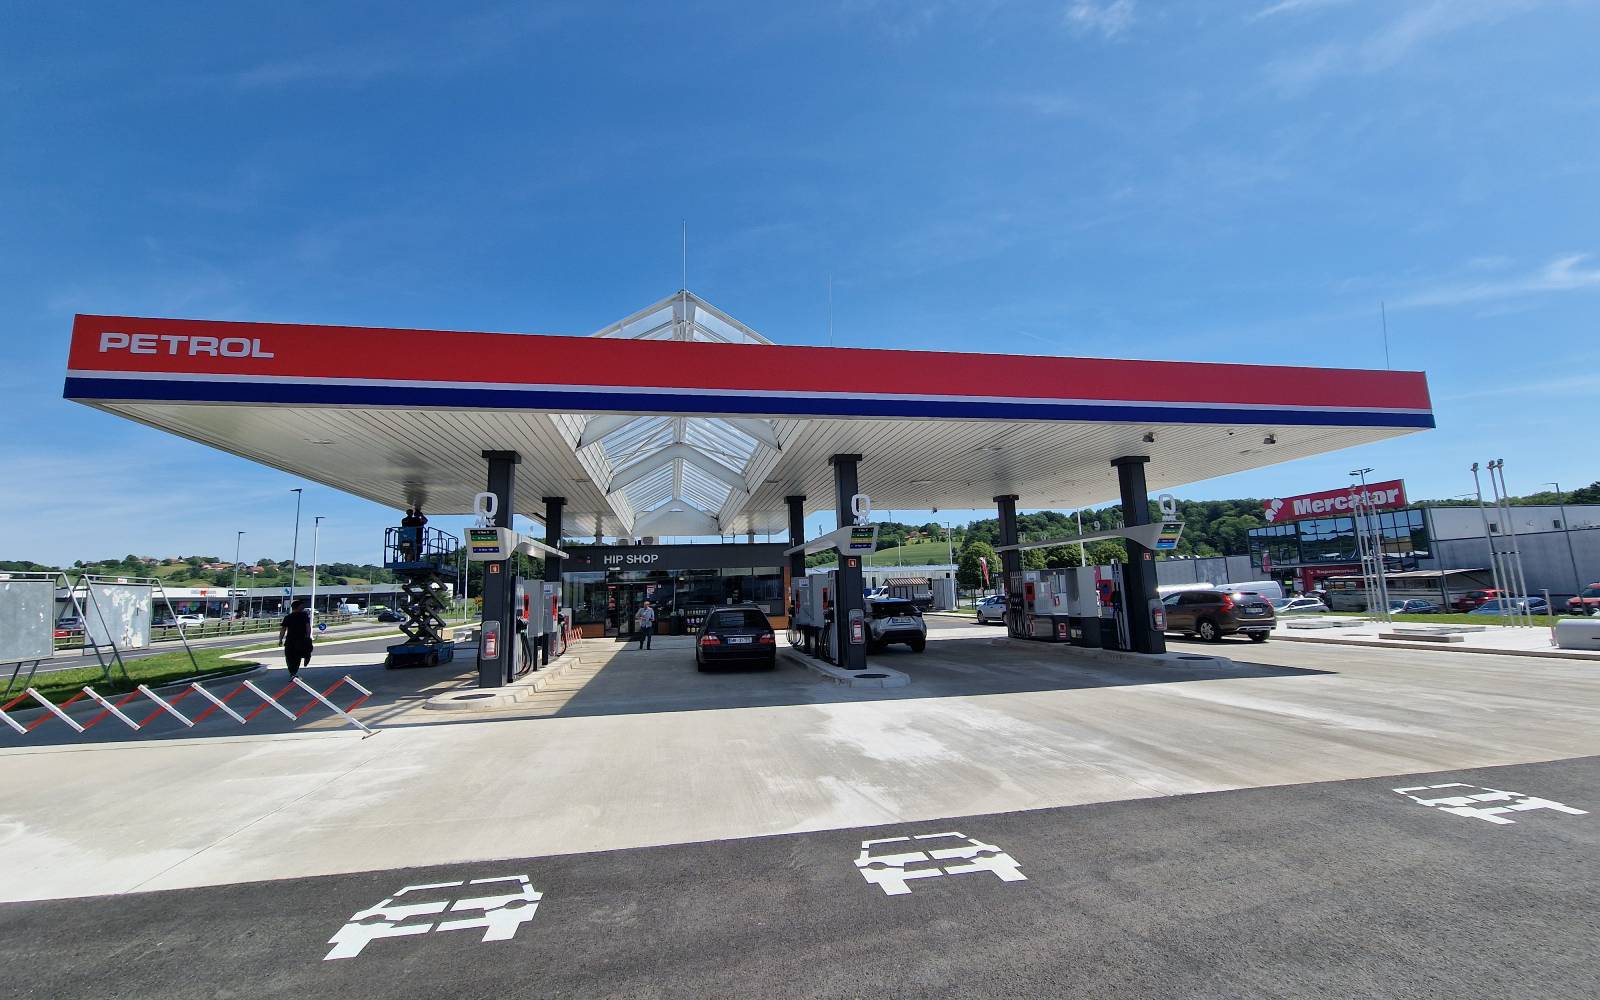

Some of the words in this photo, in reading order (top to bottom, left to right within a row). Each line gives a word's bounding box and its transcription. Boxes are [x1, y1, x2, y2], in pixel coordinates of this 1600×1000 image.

[99, 332, 275, 359] PETROL
[1158, 493, 1176, 514] Q
[1293, 488, 1399, 516] Mercator
[604, 555, 624, 564] HIP
[626, 554, 659, 564] SHOP
